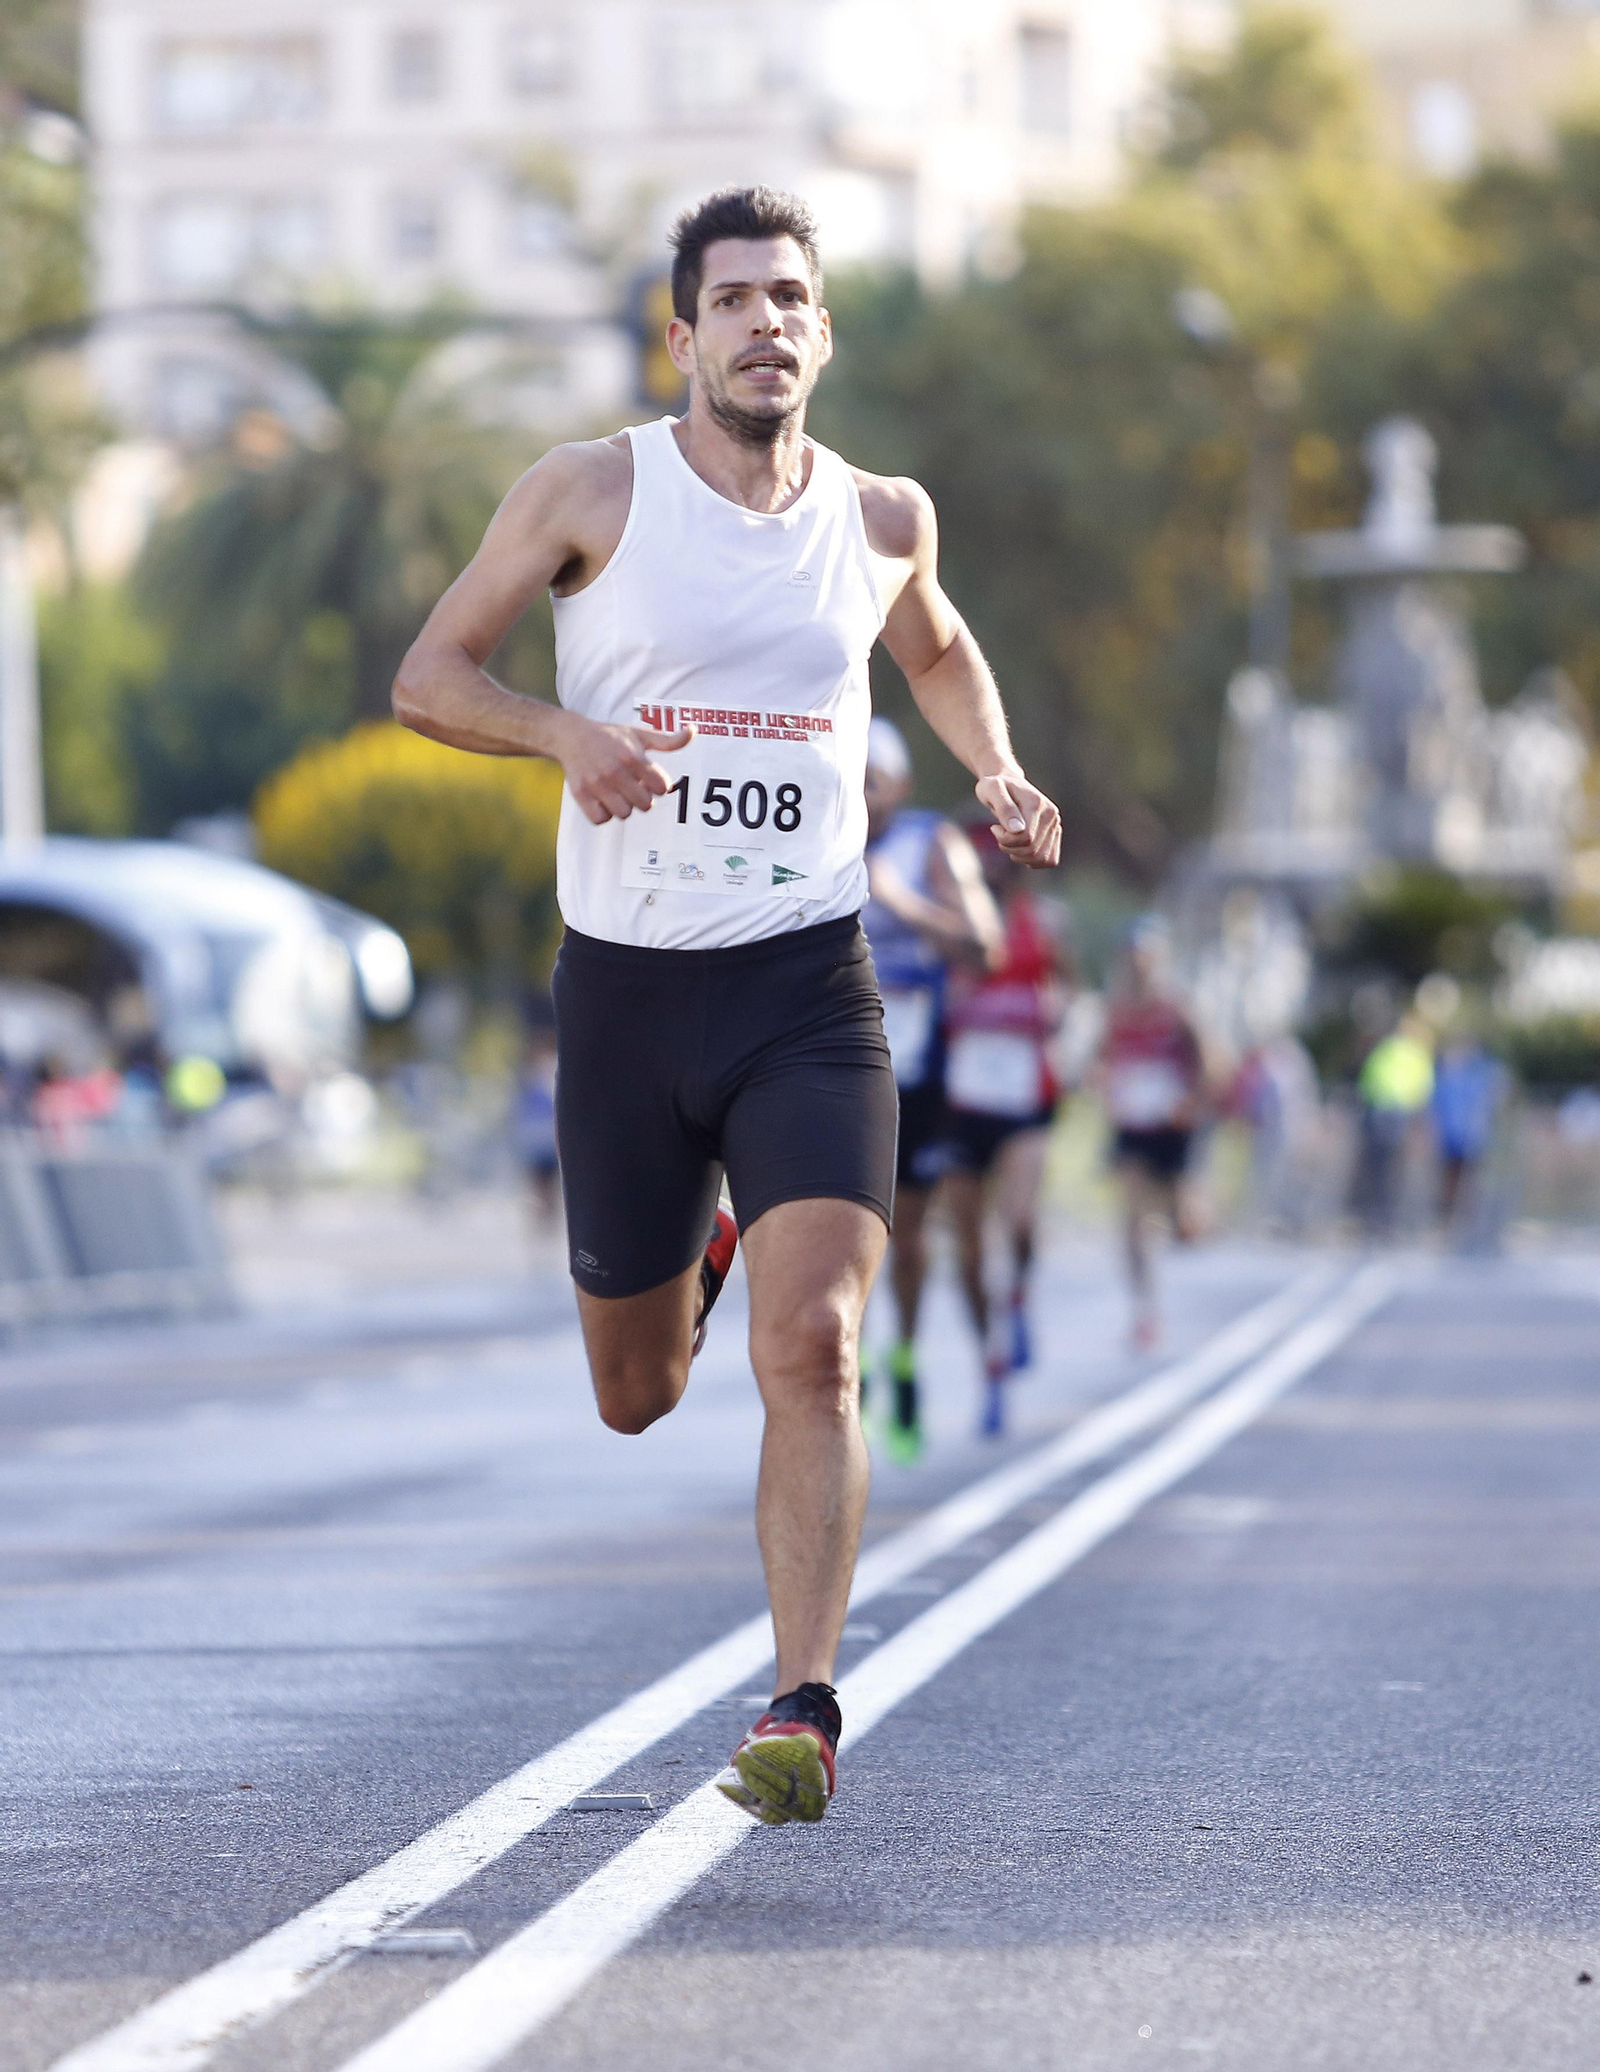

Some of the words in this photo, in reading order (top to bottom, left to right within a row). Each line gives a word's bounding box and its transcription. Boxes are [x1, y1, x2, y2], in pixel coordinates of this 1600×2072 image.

[680, 707, 761, 726] CARRERA
[733, 727, 749, 738] DE
[668, 776, 802, 832] 1508
